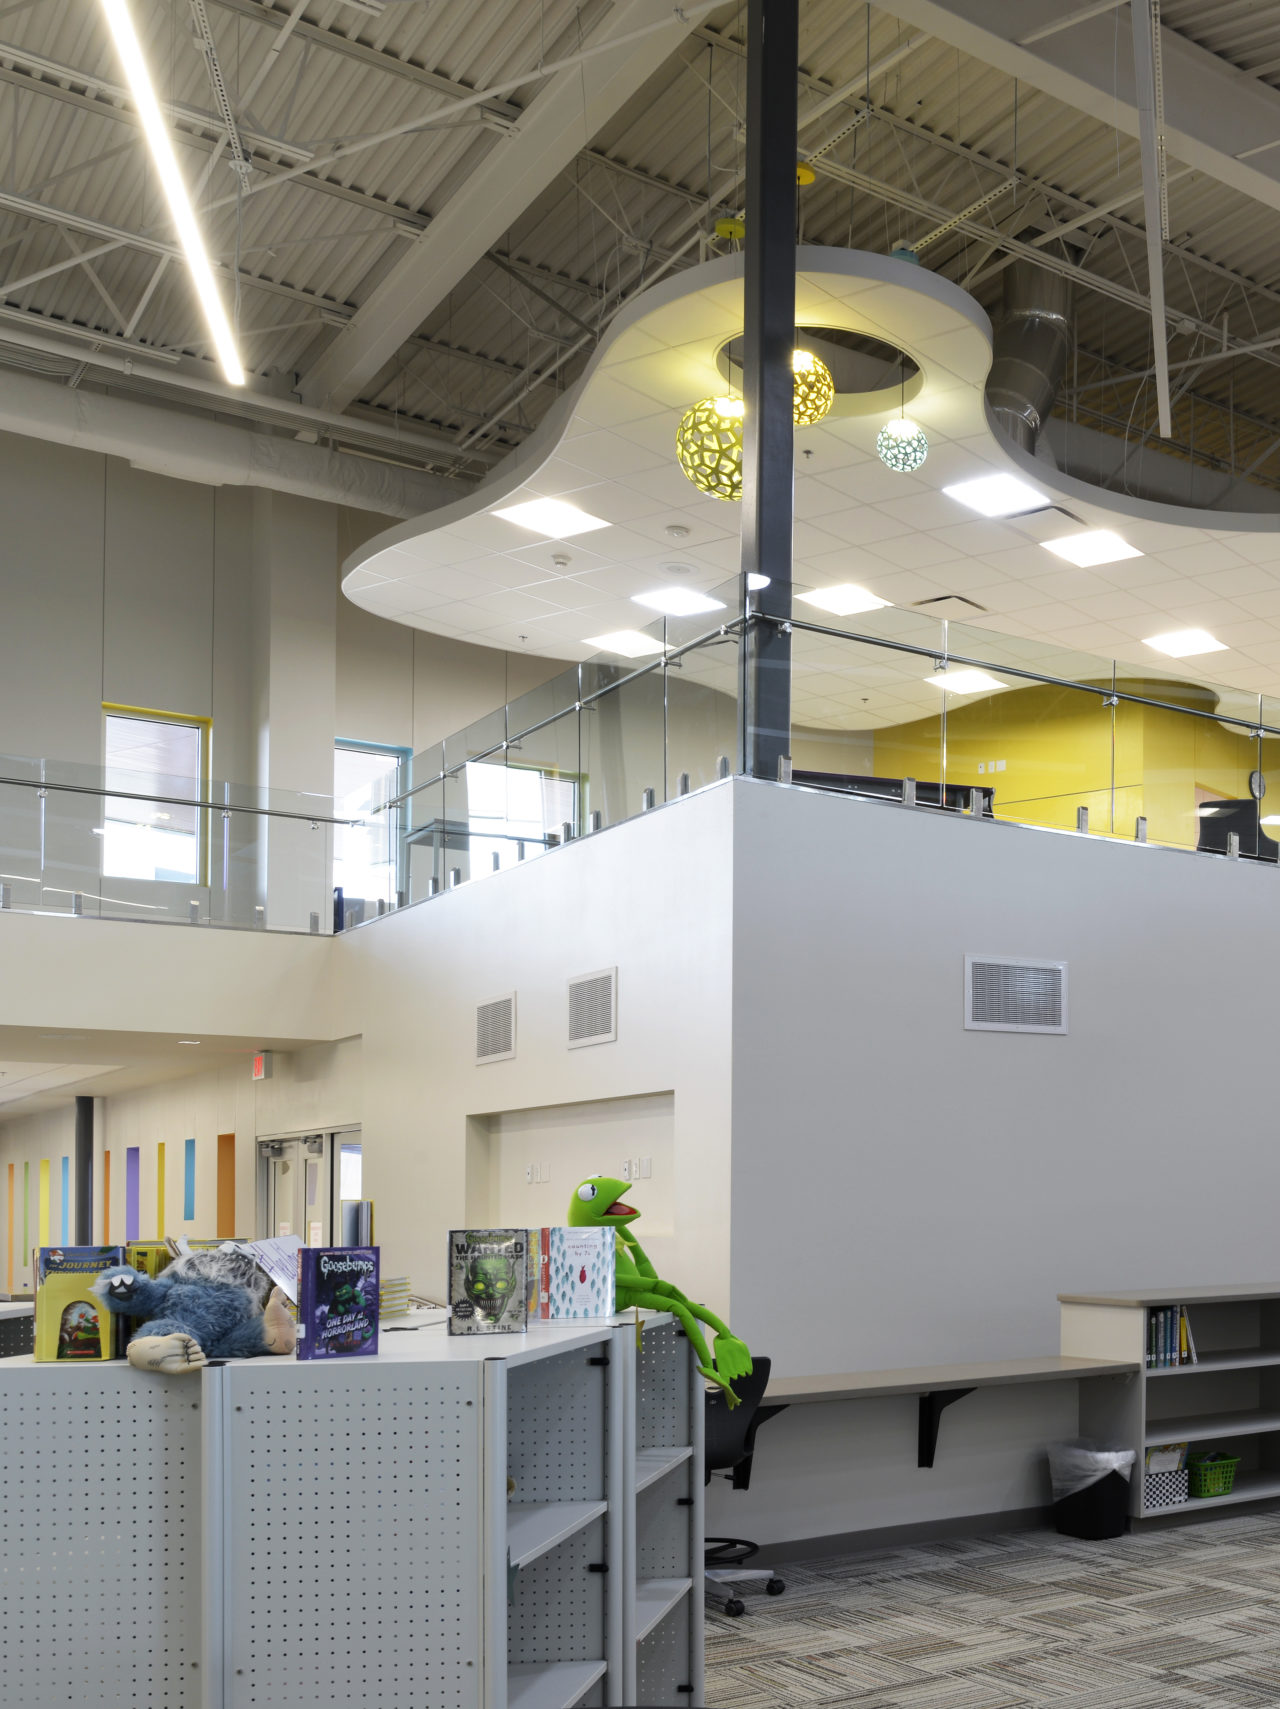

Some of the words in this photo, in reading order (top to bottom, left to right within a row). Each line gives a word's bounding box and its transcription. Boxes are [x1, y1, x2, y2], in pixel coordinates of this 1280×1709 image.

[58, 1260, 112, 1269] JOURNEY
[320, 1255, 374, 1280] Goosebumps
[326, 1316, 342, 1328] ONE
[342, 1312, 356, 1324] DAY
[321, 1319, 369, 1340] HORRORLAND
